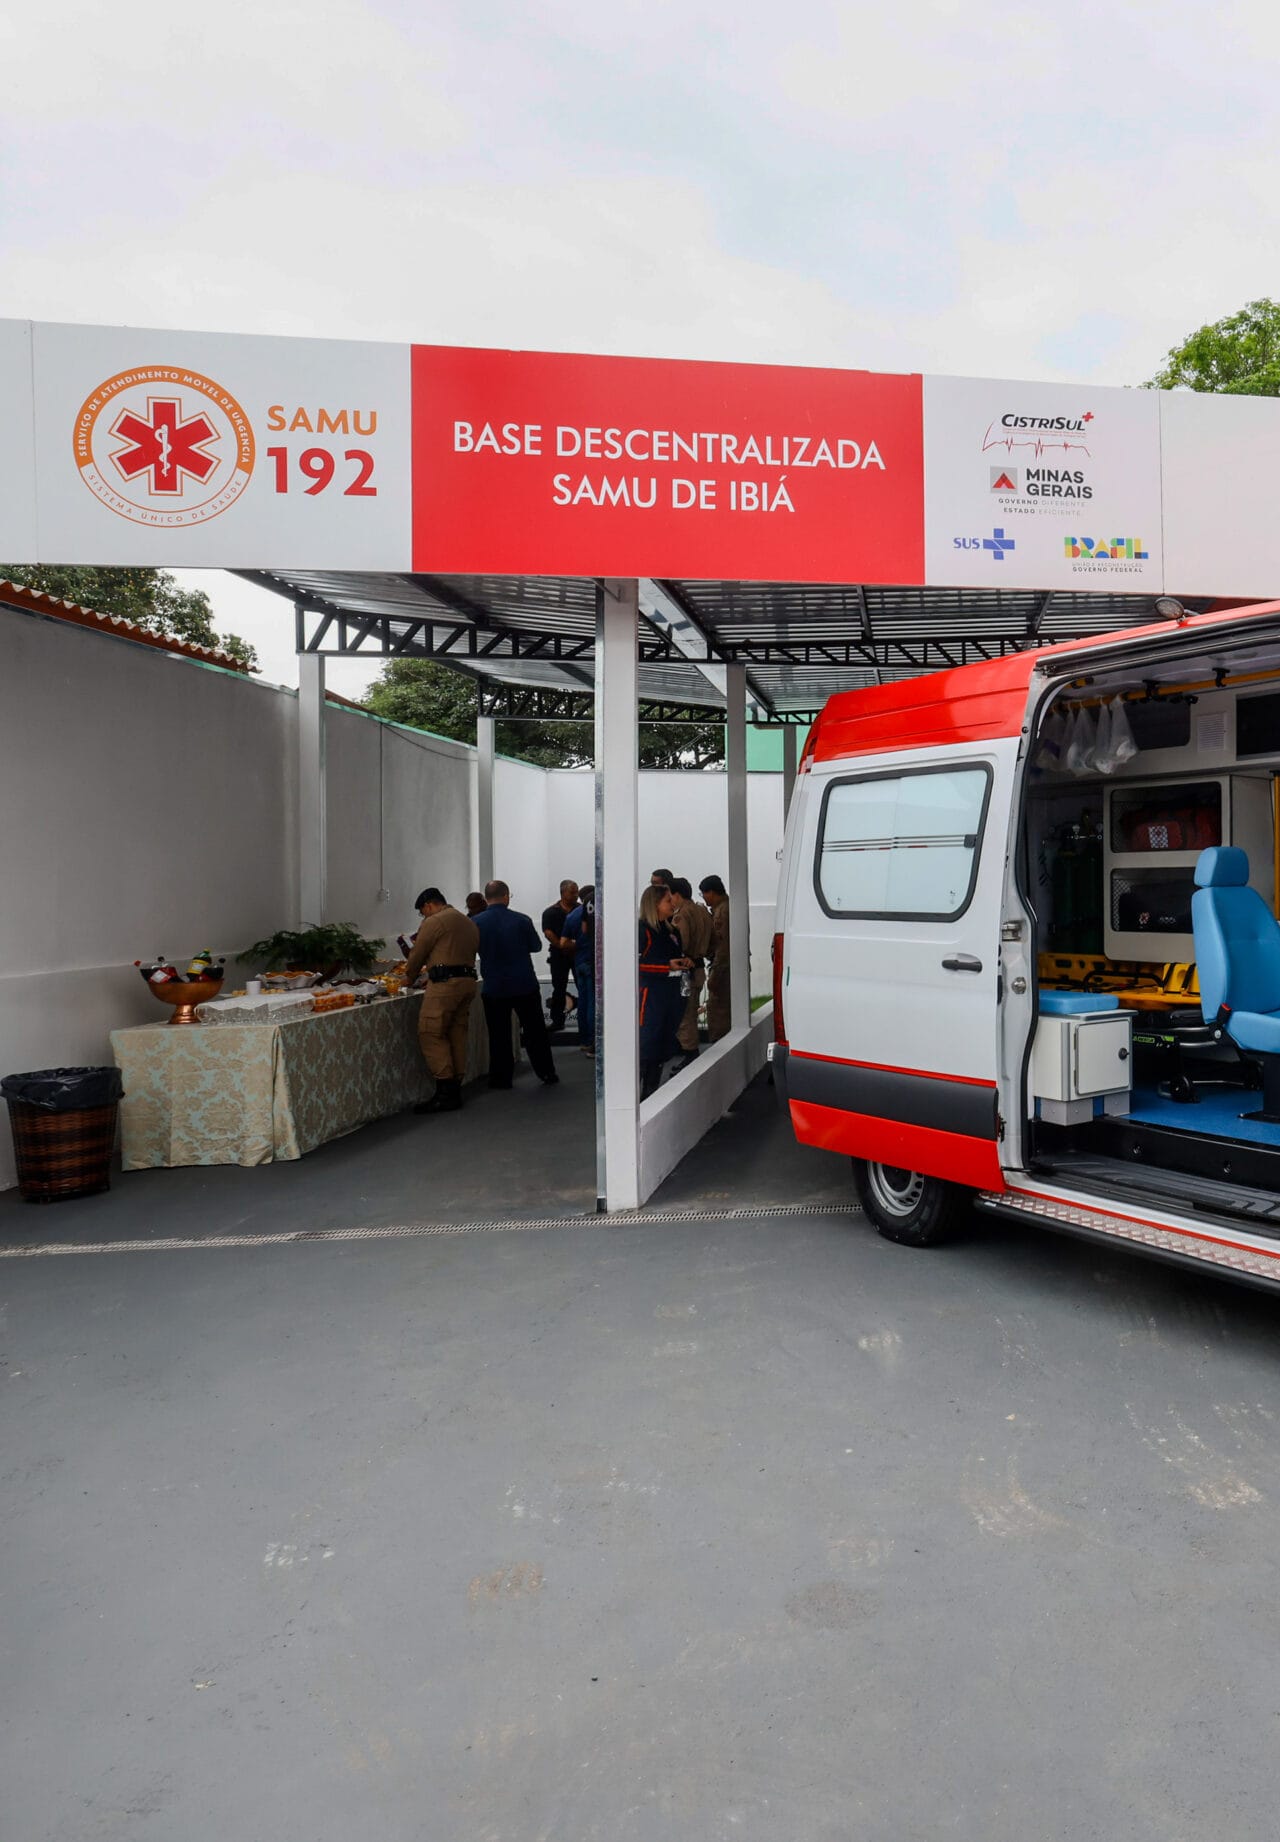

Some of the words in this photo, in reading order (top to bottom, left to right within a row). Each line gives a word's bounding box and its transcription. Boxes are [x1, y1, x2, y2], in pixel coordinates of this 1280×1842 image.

[78, 414, 92, 457] SERVIÇO
[88, 397, 101, 412] DE
[101, 371, 179, 398] ATENDIMENTO
[220, 397, 233, 410] DE
[267, 405, 377, 436] SAMU
[453, 421, 542, 456] BASE
[556, 426, 886, 471] DESCENTRALIZADA
[267, 446, 377, 497] 192
[1026, 468, 1084, 484] MINAS
[88, 474, 133, 515] SISTEMA
[191, 509, 206, 520] DE
[552, 473, 657, 508] SAMU
[672, 478, 716, 510] DE
[730, 475, 795, 513] IBIÁ
[1026, 483, 1093, 500] GERAIS
[953, 537, 980, 550] SUS
[1064, 537, 1149, 559] BRASIL
